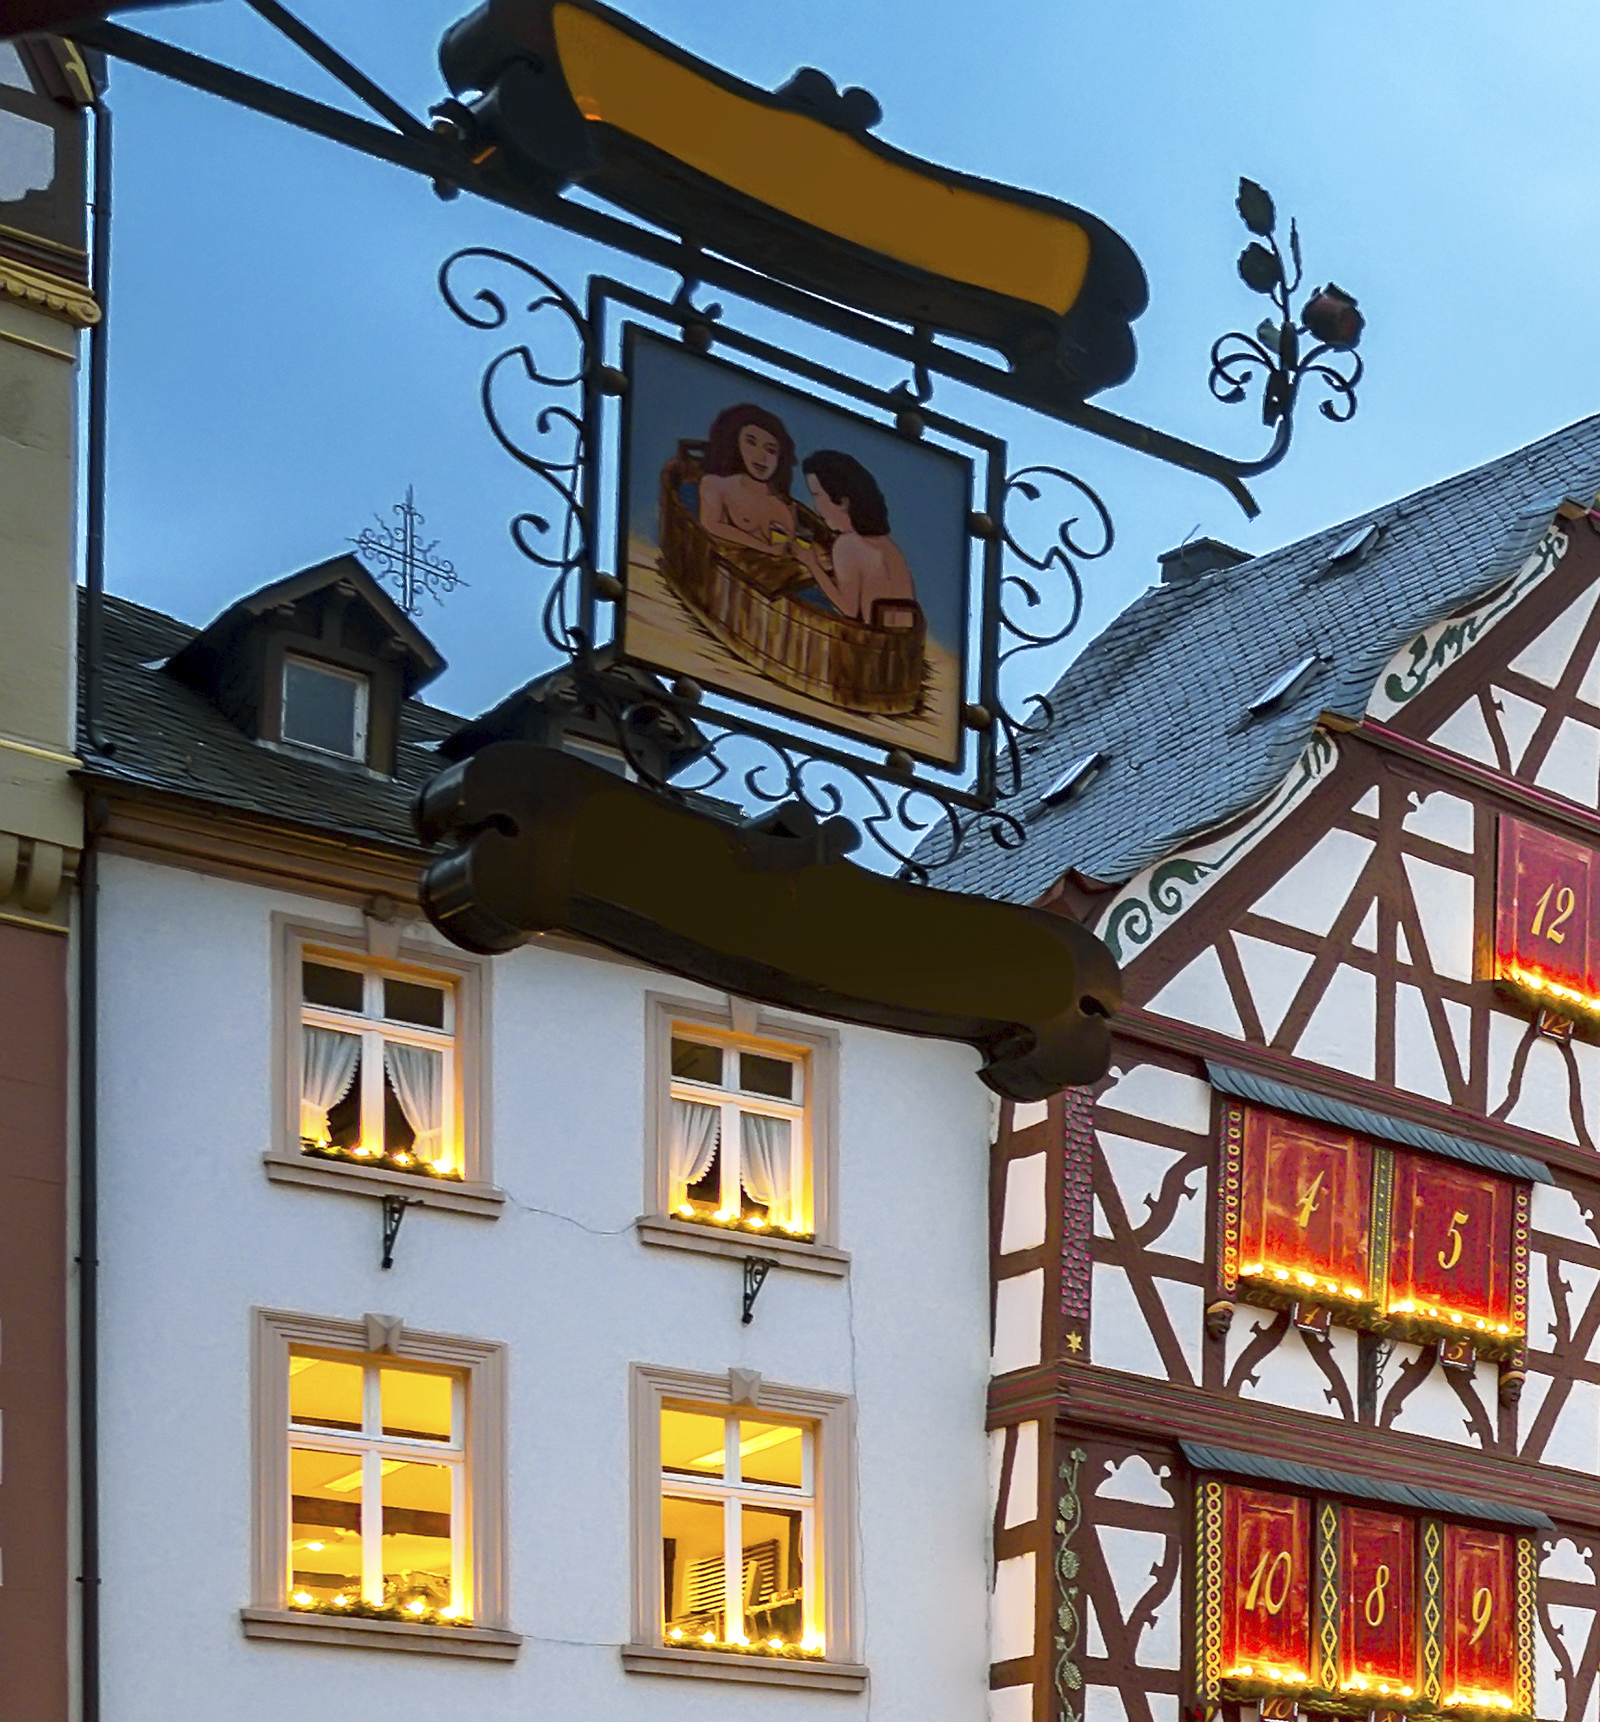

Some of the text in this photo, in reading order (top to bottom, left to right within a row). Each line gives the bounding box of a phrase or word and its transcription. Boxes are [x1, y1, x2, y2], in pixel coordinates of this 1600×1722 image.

[1531, 883, 1575, 944] 12
[1296, 1171, 1470, 1270] 4 5
[1244, 1551, 1492, 1646] 10 8 9
